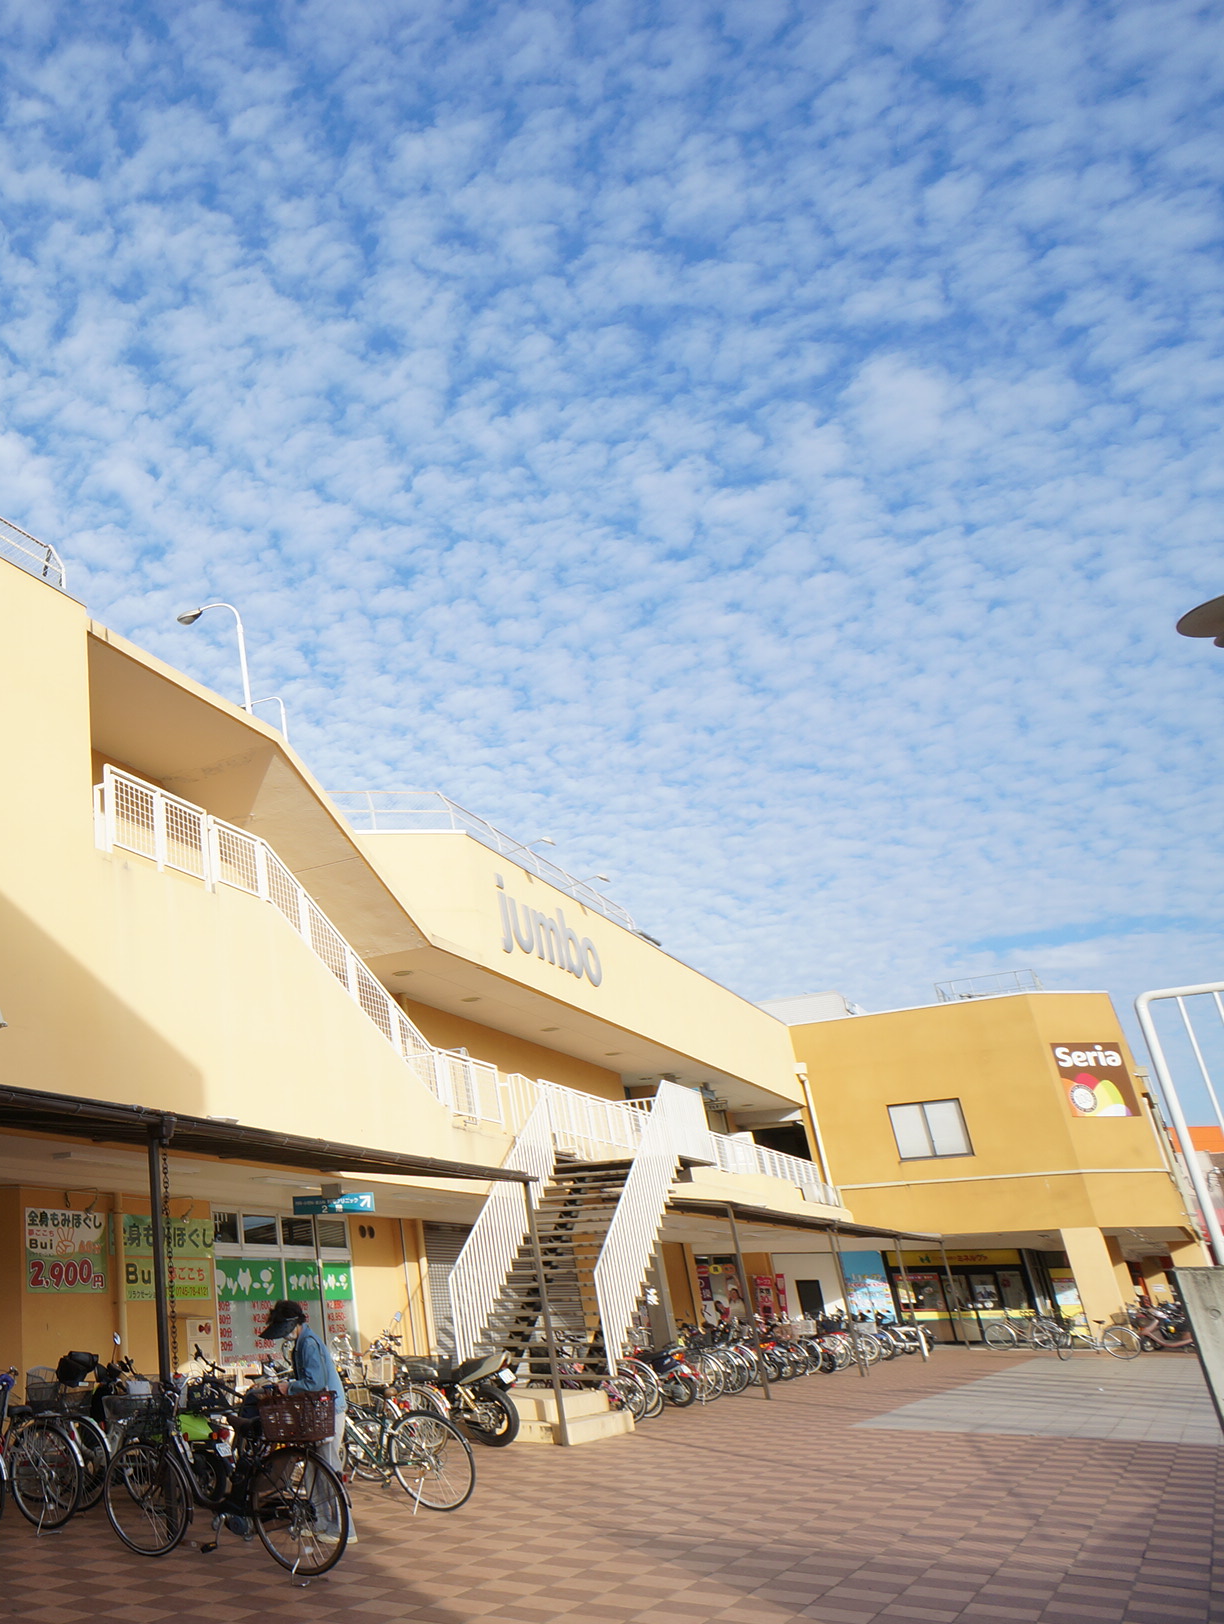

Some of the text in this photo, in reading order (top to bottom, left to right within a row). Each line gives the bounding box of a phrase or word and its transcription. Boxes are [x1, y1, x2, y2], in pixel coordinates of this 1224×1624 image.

[495, 872, 602, 987] jumbo
[1055, 1045, 1122, 1067] Seria
[28, 1210, 102, 1229] 全身もみほぐし
[321, 1205, 328, 1213] 2
[29, 1239, 53, 1250] Bui
[29, 1257, 105, 1290] 2,900円
[126, 1263, 152, 1284] Bu
